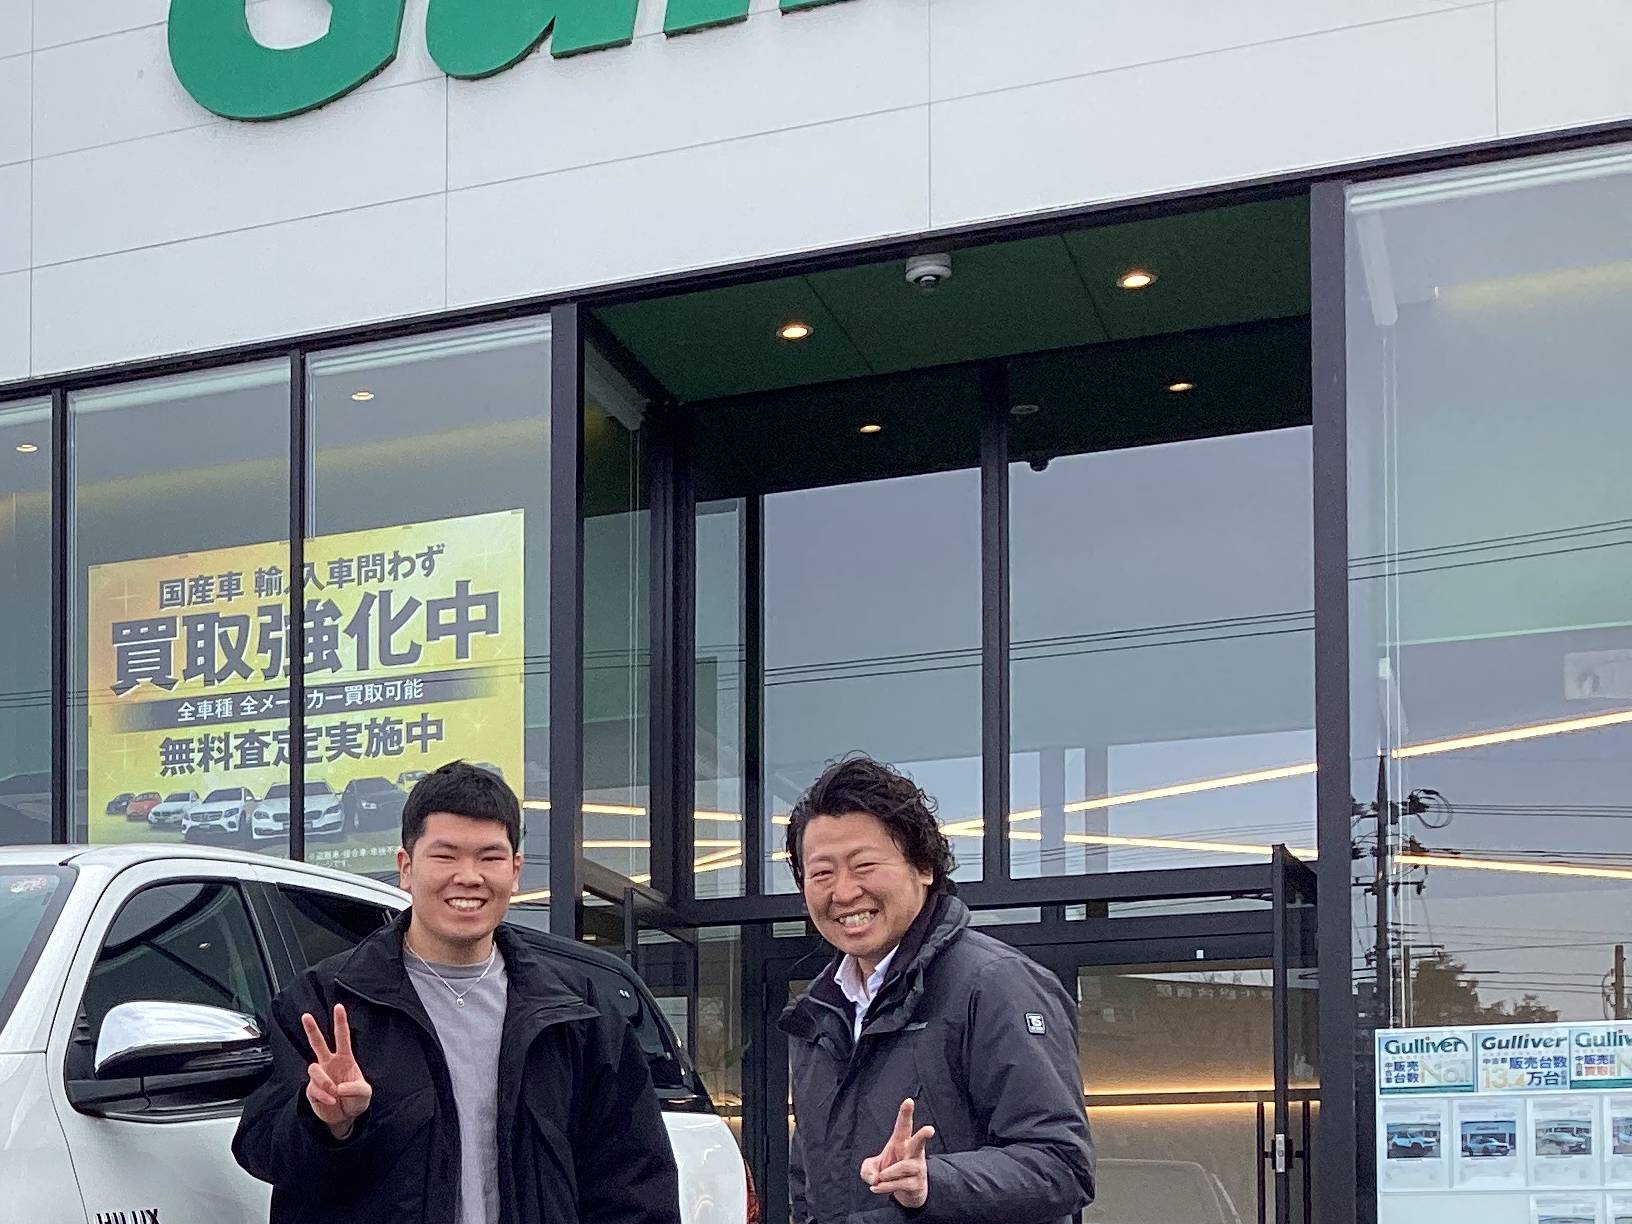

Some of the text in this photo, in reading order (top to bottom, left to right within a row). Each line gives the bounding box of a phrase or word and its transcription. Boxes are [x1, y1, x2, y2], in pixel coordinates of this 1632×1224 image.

[159, 544, 445, 609] 国産車 輸入車問わず
[111, 579, 500, 697] 買取強化中
[176, 678, 424, 722] 全車種 全メーカー買取可能
[158, 713, 444, 776] 無料査定実施中
[1384, 1036, 1469, 1055] Gulliver
[1481, 1033, 1567, 1051] Gulliver
